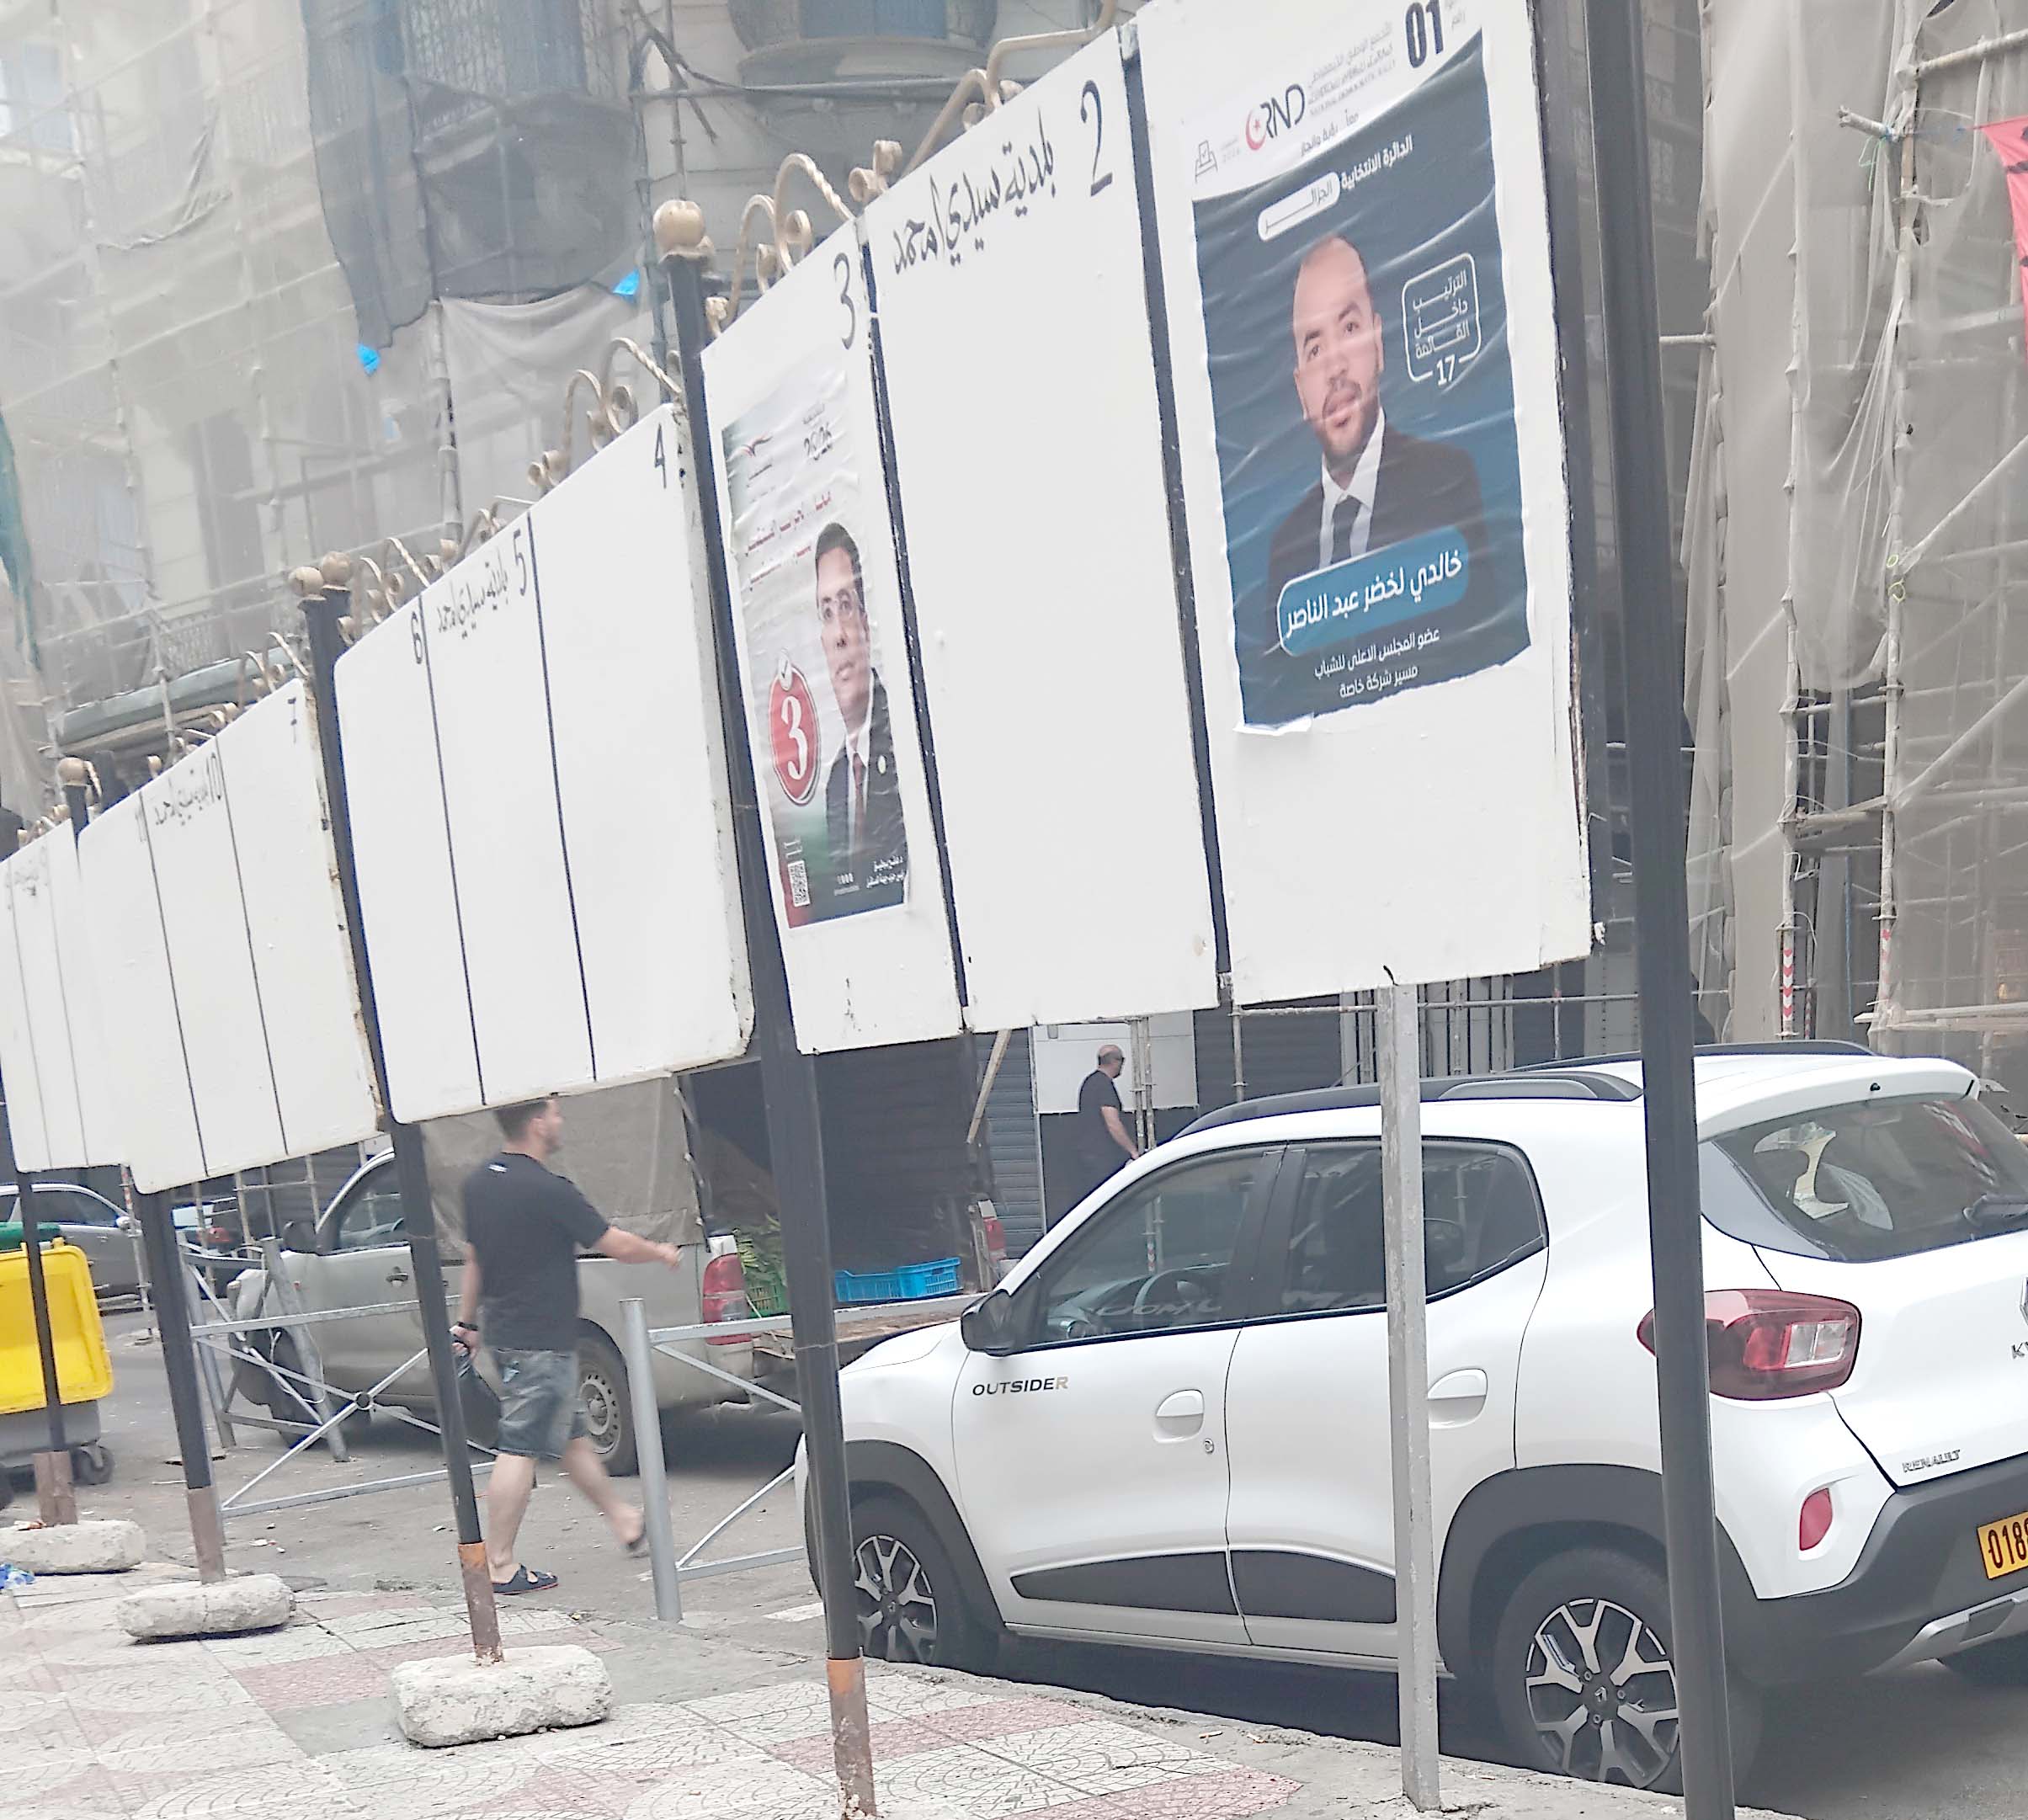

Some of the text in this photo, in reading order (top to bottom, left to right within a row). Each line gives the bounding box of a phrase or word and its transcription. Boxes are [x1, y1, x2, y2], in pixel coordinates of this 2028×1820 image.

[1405, 0, 1444, 68] 01
[1080, 80, 1113, 197] 2
[1383, 134, 1413, 168] الدائرة
[1001, 105, 1057, 218] بلدية
[1340, 152, 1381, 190] الانتخابية
[945, 164, 1001, 267] سيدي
[833, 252, 856, 350] 3
[1412, 269, 1467, 314] الترتيب
[1414, 298, 1468, 338] داخل
[1415, 319, 1470, 359] القائمة
[1436, 354, 1456, 386] 17
[654, 423, 668, 489] 4
[513, 529, 528, 597] 5
[1285, 549, 1462, 639] خالدي لخضر عبد الناصر
[411, 611, 423, 664] 6
[1378, 632, 1415, 662] المجلس
[1417, 628, 1440, 650] عضو
[1314, 654, 1345, 680] للشباب
[1339, 665, 1419, 698] مسير شركة خاصة
[780, 695, 808, 780] 3
[971, 1376, 1069, 1397] OUTSIDER
[1902, 1450, 1961, 1473] RENAULT
